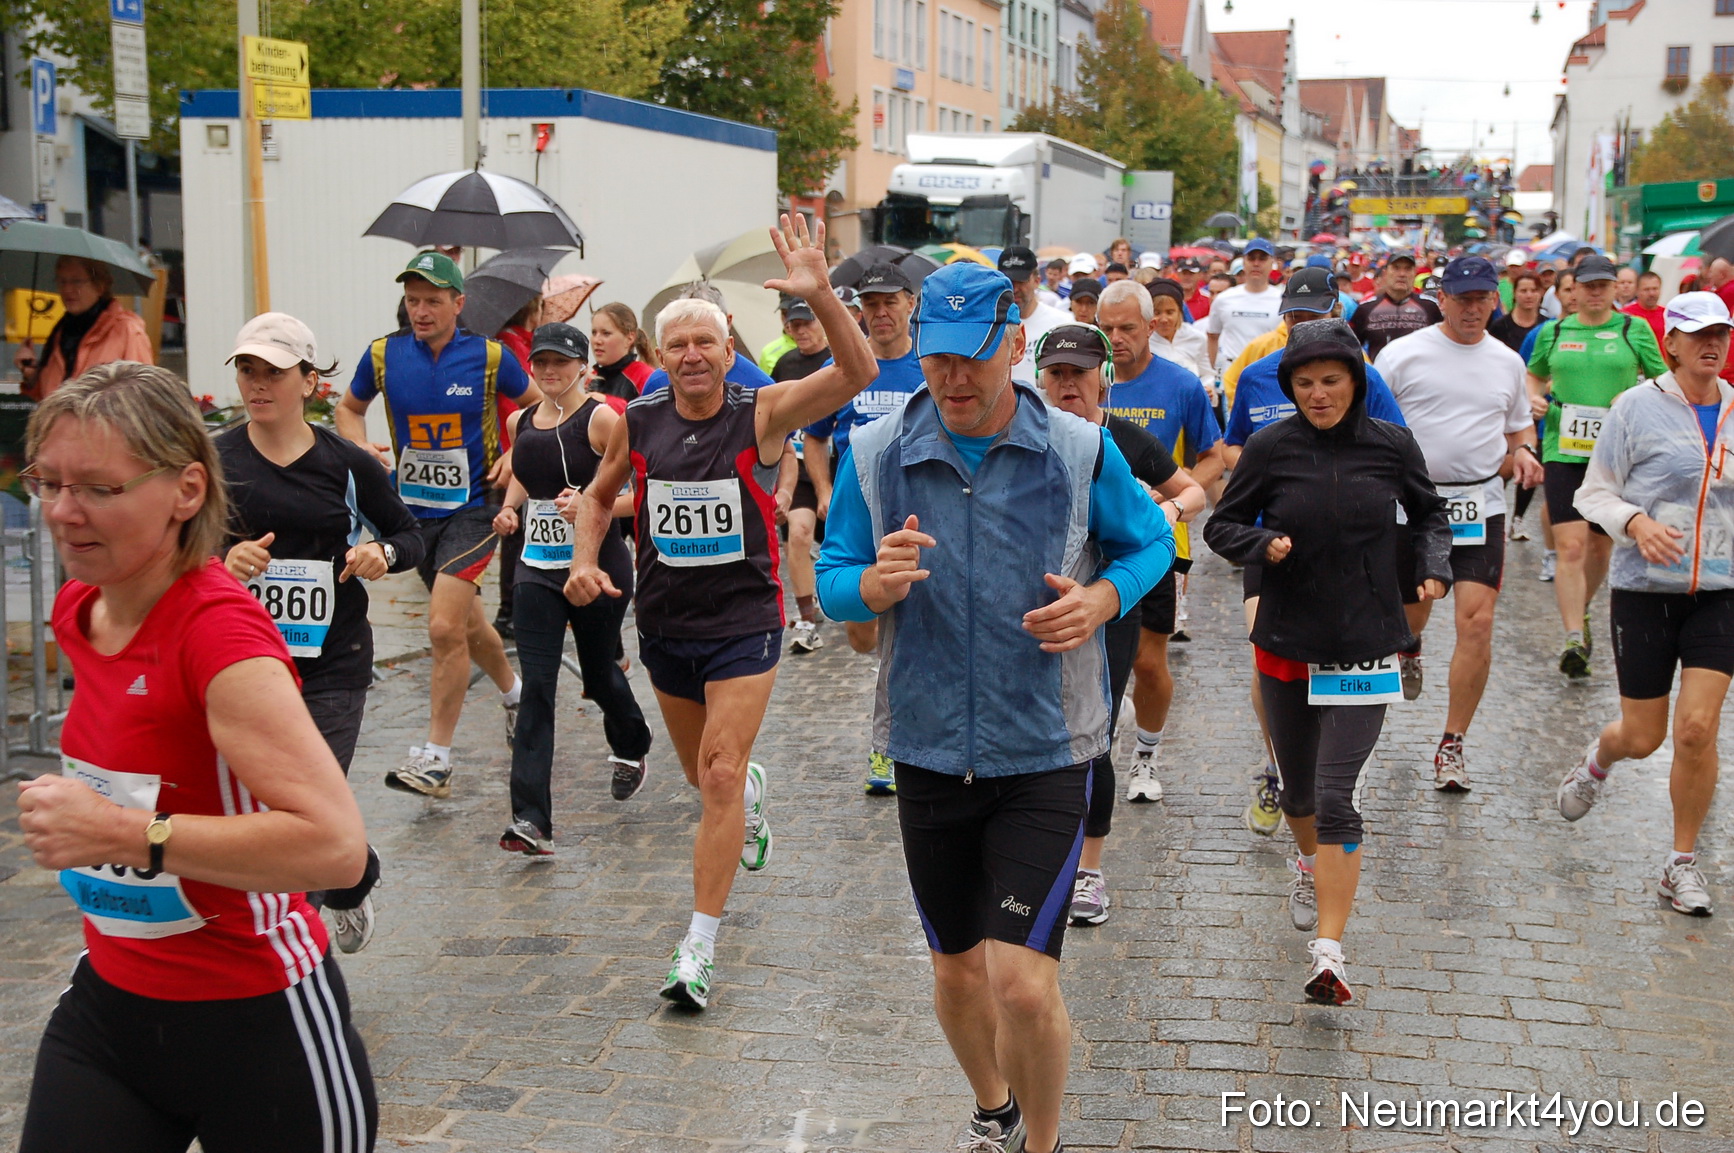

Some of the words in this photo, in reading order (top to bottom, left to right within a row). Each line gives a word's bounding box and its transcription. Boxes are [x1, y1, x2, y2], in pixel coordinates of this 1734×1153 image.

[257, 43, 291, 59] Kinder-
[251, 60, 298, 82] betreuung
[37, 67, 51, 126] P
[919, 175, 980, 189] BOCK
[1387, 202, 1427, 211] START
[446, 384, 473, 396] asics
[403, 462, 462, 487] 2463
[421, 487, 446, 500] Franz
[672, 487, 709, 496] BOCK
[657, 503, 733, 535] 2619
[542, 549, 571, 559] Sabine
[670, 541, 719, 554] Gerhard
[1340, 679, 1371, 692] Erika
[77, 880, 154, 916] Waltraud
[1001, 896, 1031, 916] asics
